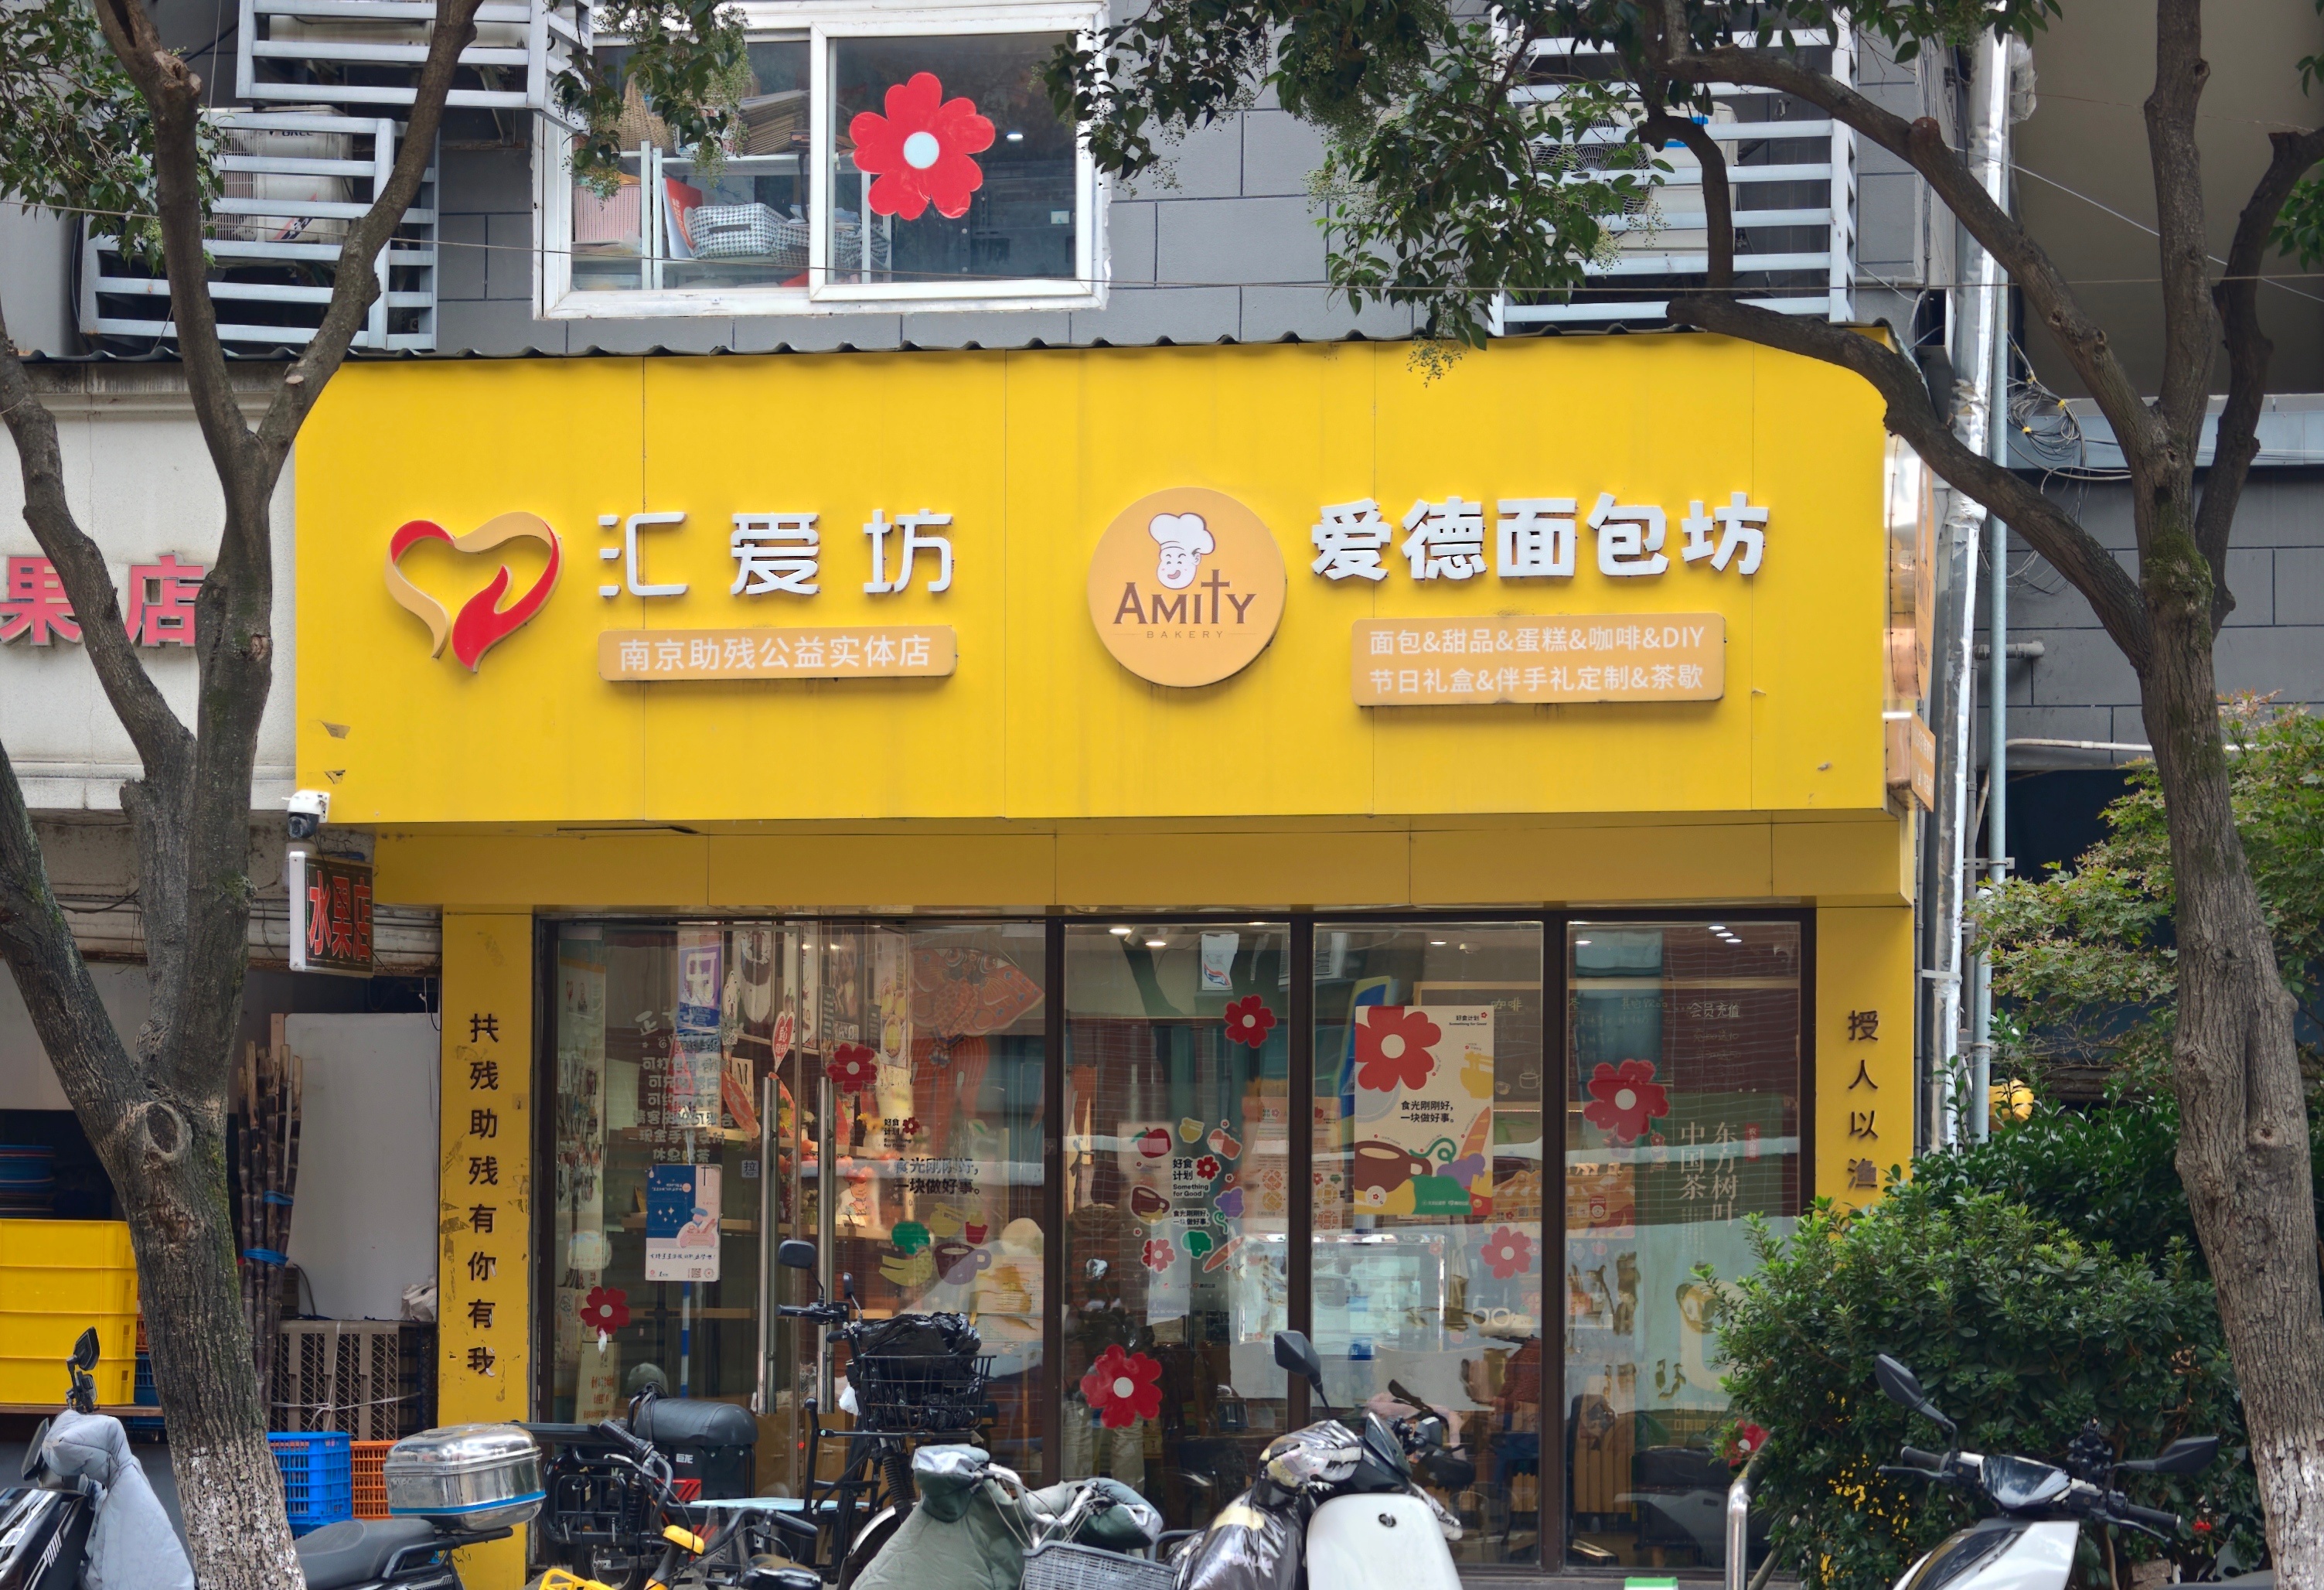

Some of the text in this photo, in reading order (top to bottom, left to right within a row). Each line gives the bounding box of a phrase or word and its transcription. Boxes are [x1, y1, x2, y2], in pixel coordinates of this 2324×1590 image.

[598, 508, 954, 596] 汇爱坊
[1310, 491, 1769, 582] 爱德面包坊
[1147, 630, 1223, 639] BAKERY
[1369, 624, 1704, 657] 面包&甜品&蛋糕&咖啡&DIY
[619, 634, 931, 672] 南京助残公益实体店
[1369, 664, 1703, 695] 节日礼盒&伴手礼定制&茶歇
[308, 870, 371, 963] 水果店
[1690, 1002, 1740, 1018] 会员充值
[1400, 1113, 1454, 1123] 一块做好事。
[1847, 1009, 1879, 1230] 授人以渔
[744, 1162, 757, 1171] 拉
[1173, 1158, 1193, 1169] 好食
[1173, 1170, 1193, 1181] 计划
[1679, 1121, 1707, 1199] 中国茶
[1711, 1121, 1739, 1227] 东方树叶
[467, 1013, 499, 1377] 扶残助残有你有我
[1173, 1183, 1209, 1192] Something
